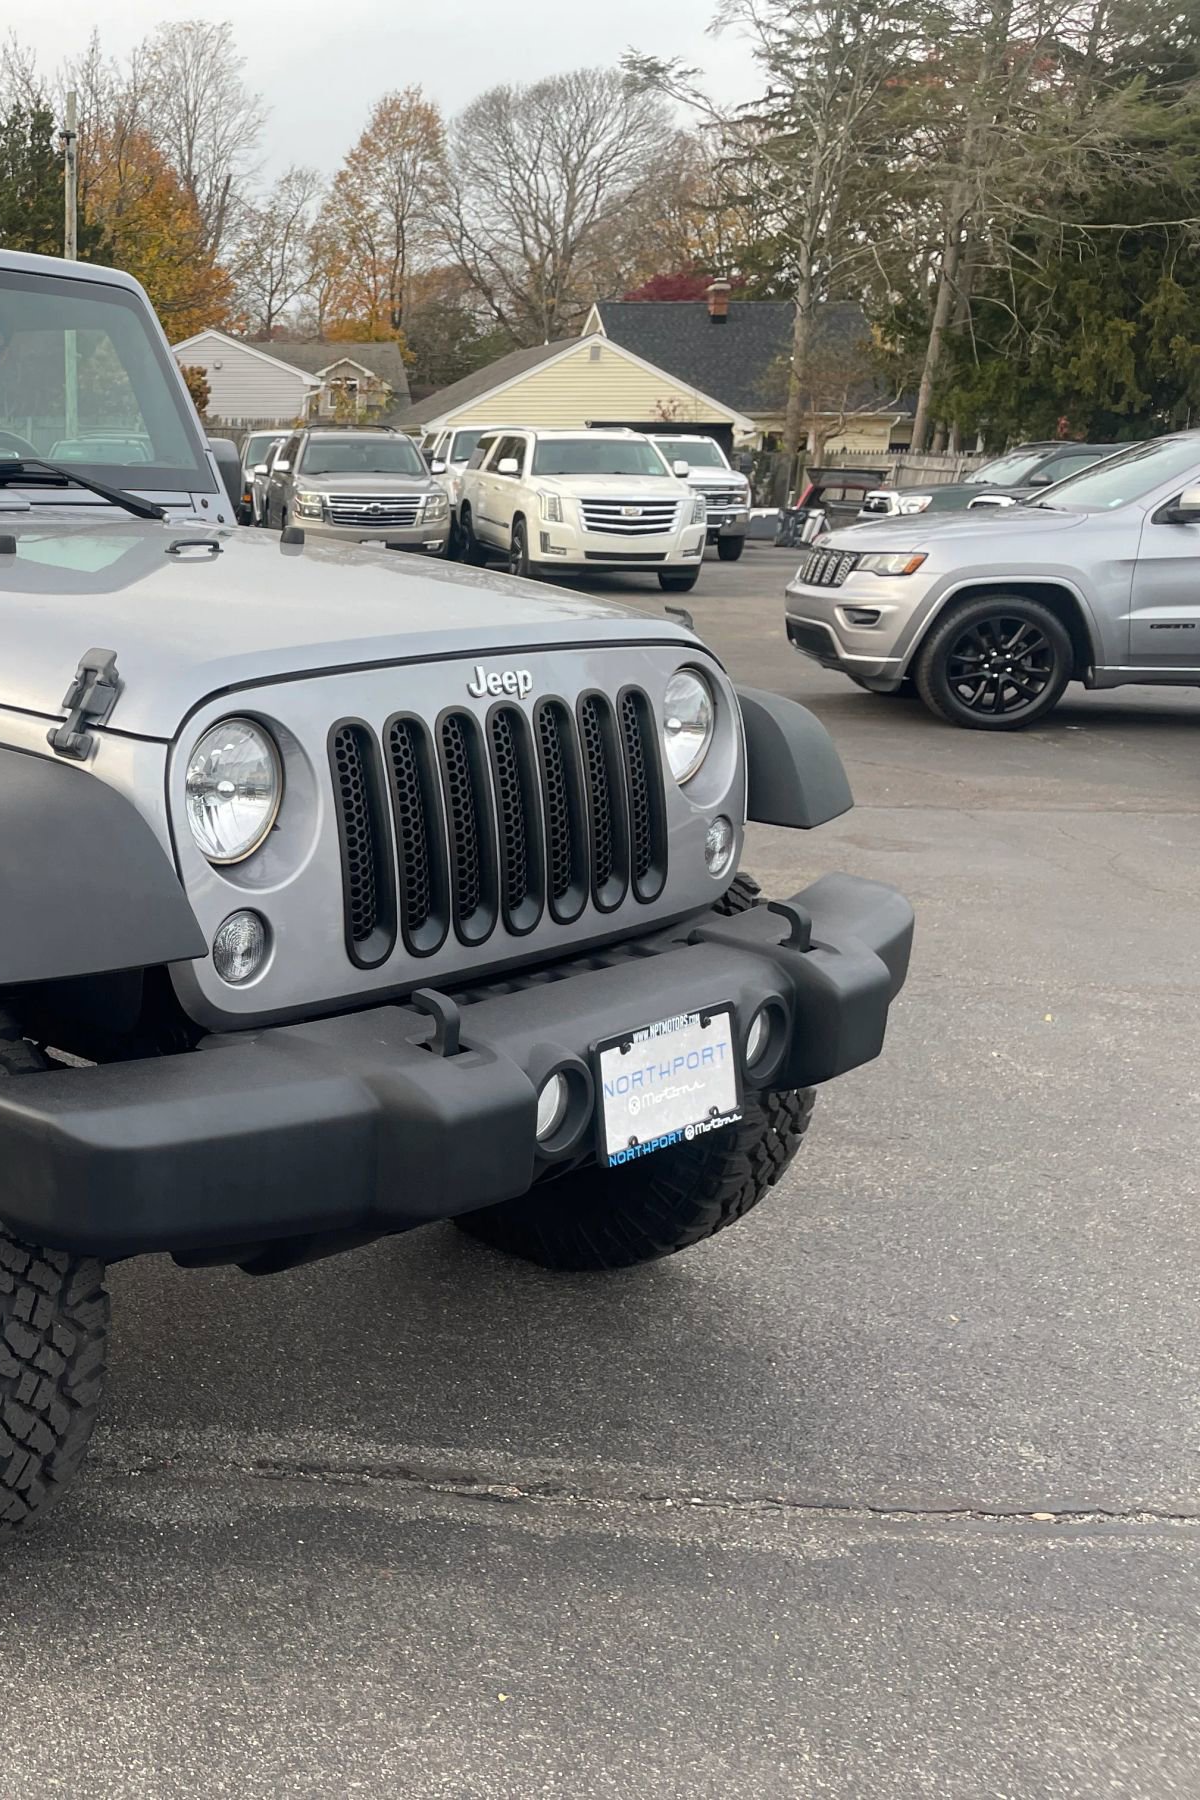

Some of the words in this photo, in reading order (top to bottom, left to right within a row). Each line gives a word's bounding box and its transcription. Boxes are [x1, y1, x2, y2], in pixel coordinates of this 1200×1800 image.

[467, 665, 533, 700] Jeep
[604, 1042, 728, 1099] NORTHPORT
[640, 1080, 707, 1107] Motors
[608, 1129, 685, 1168] NORTHPORT
[694, 1113, 743, 1136] Motors
